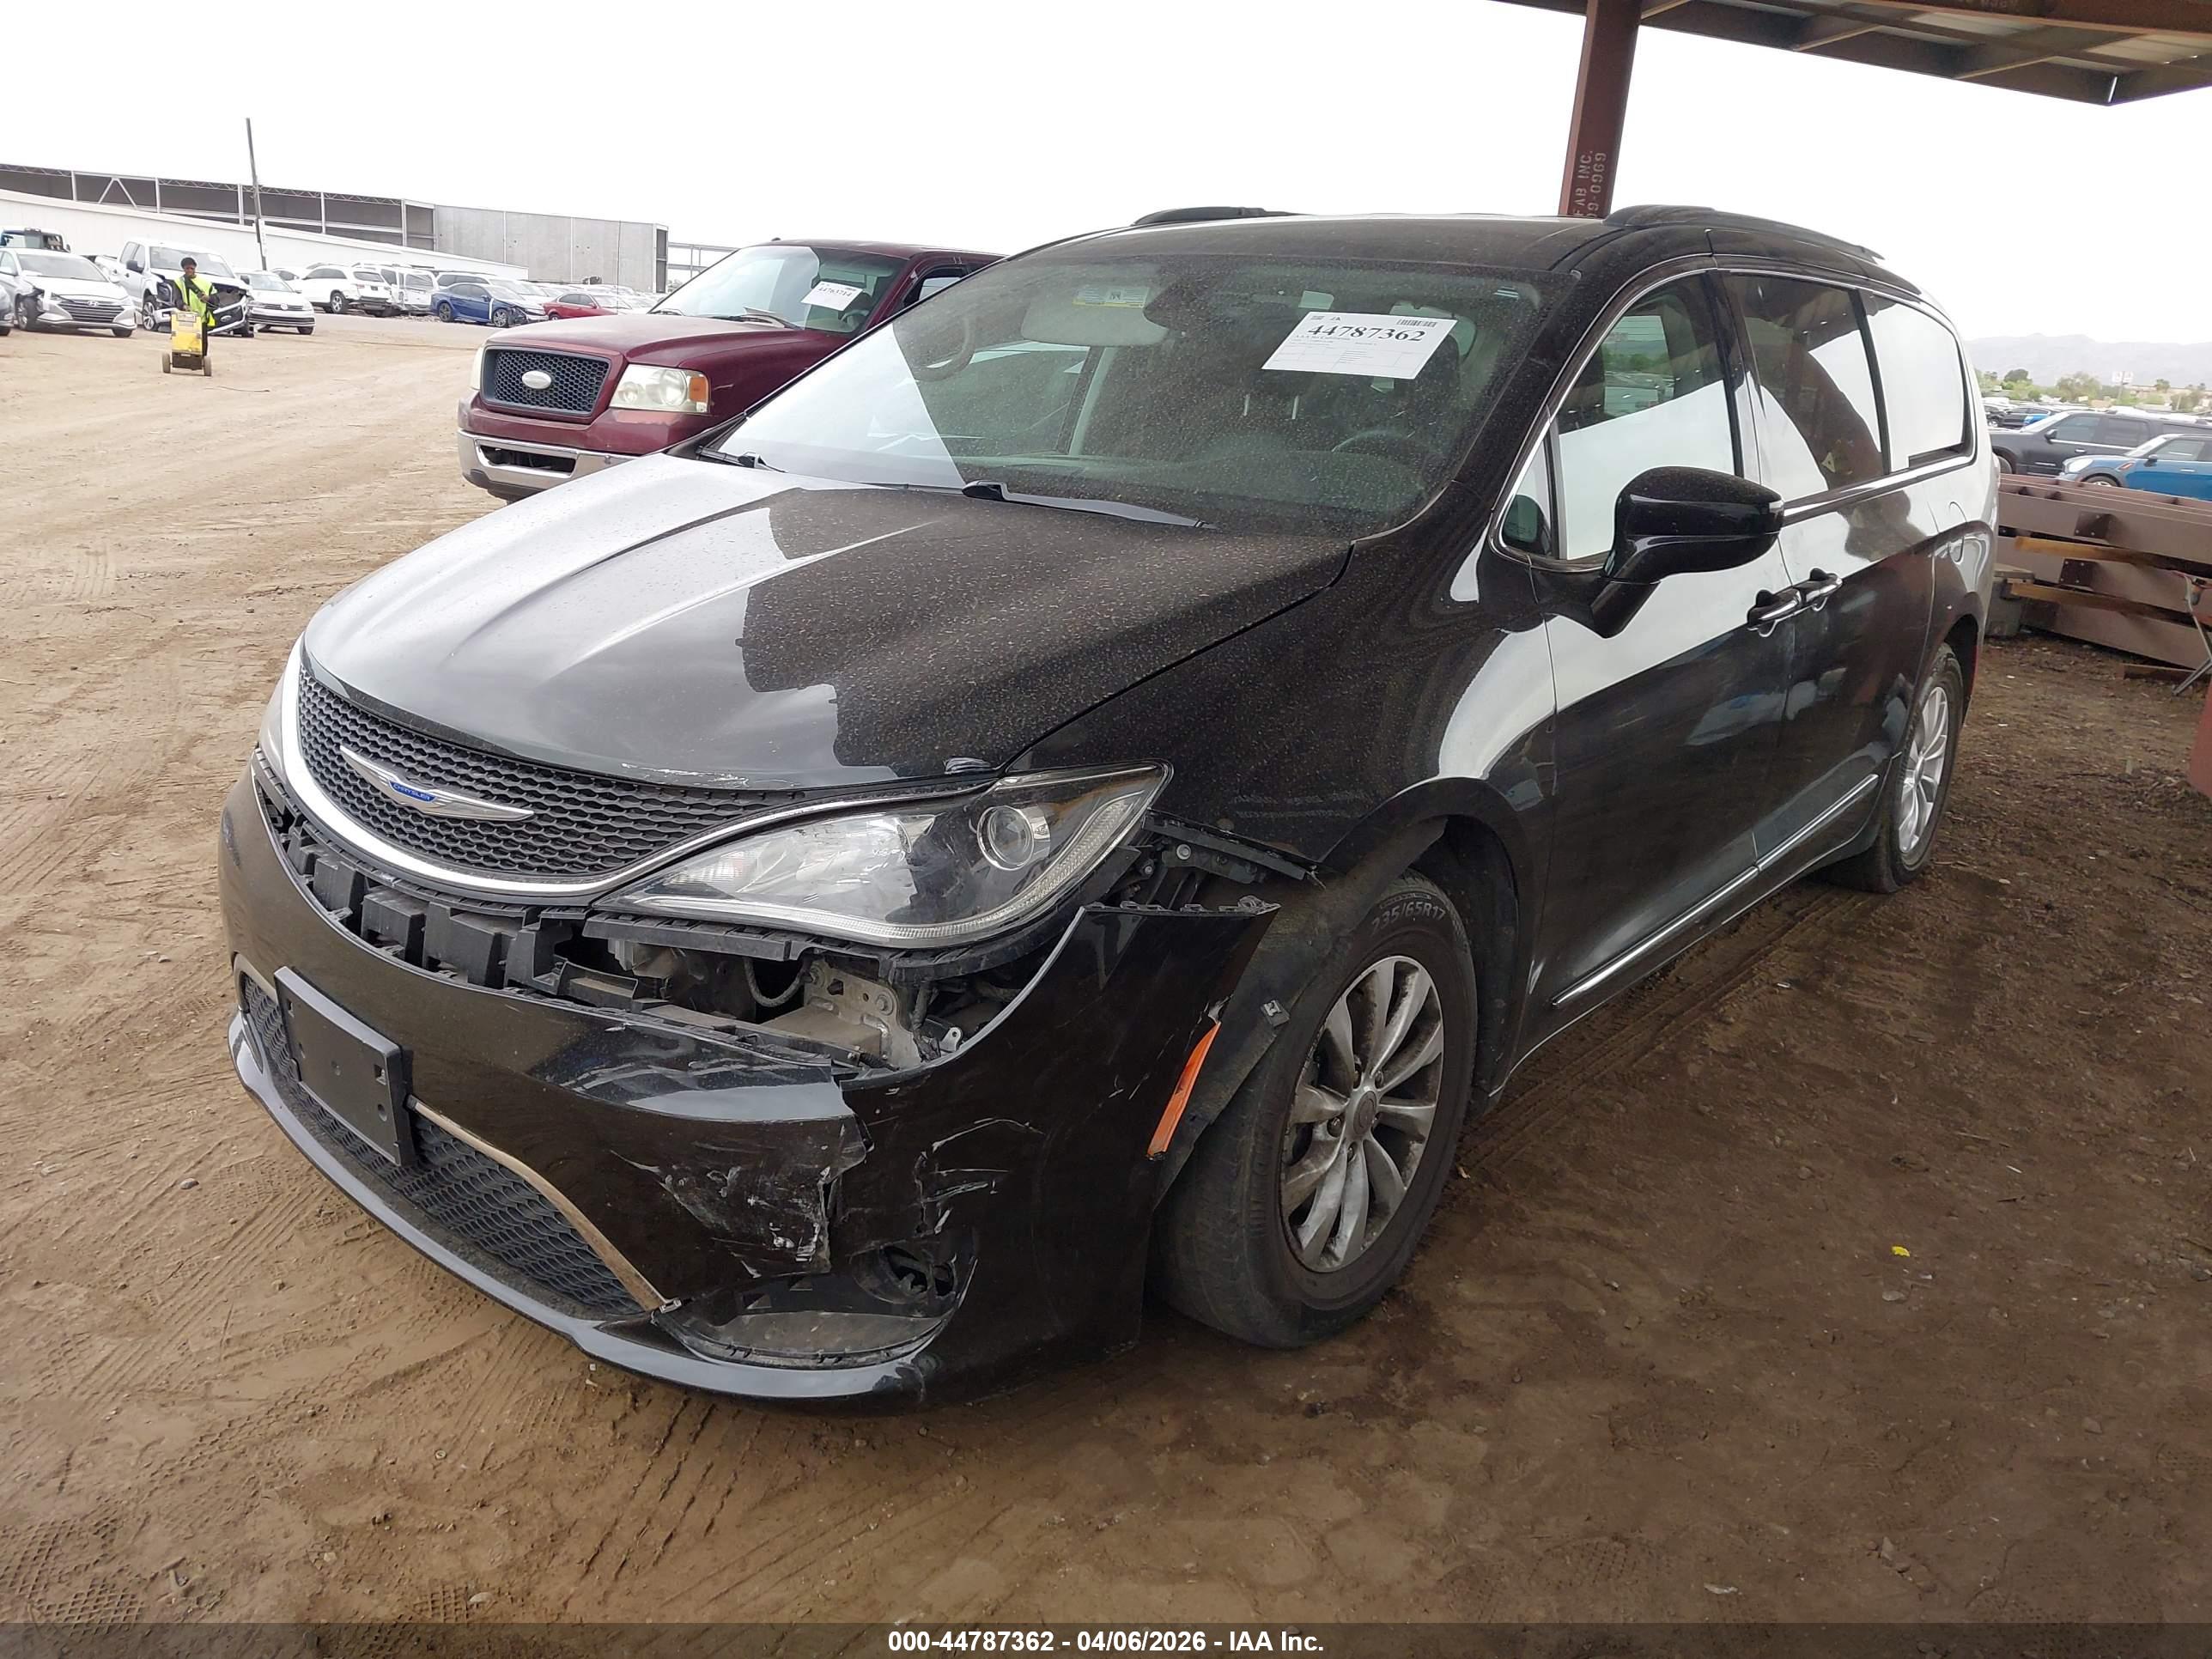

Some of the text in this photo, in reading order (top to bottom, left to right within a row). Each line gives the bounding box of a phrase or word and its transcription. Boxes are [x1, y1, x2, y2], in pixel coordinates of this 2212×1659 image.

[1577, 150, 1593, 179] INC.
[1307, 324, 1426, 343] 44787362
[392, 782, 431, 800] CHRYSLER
